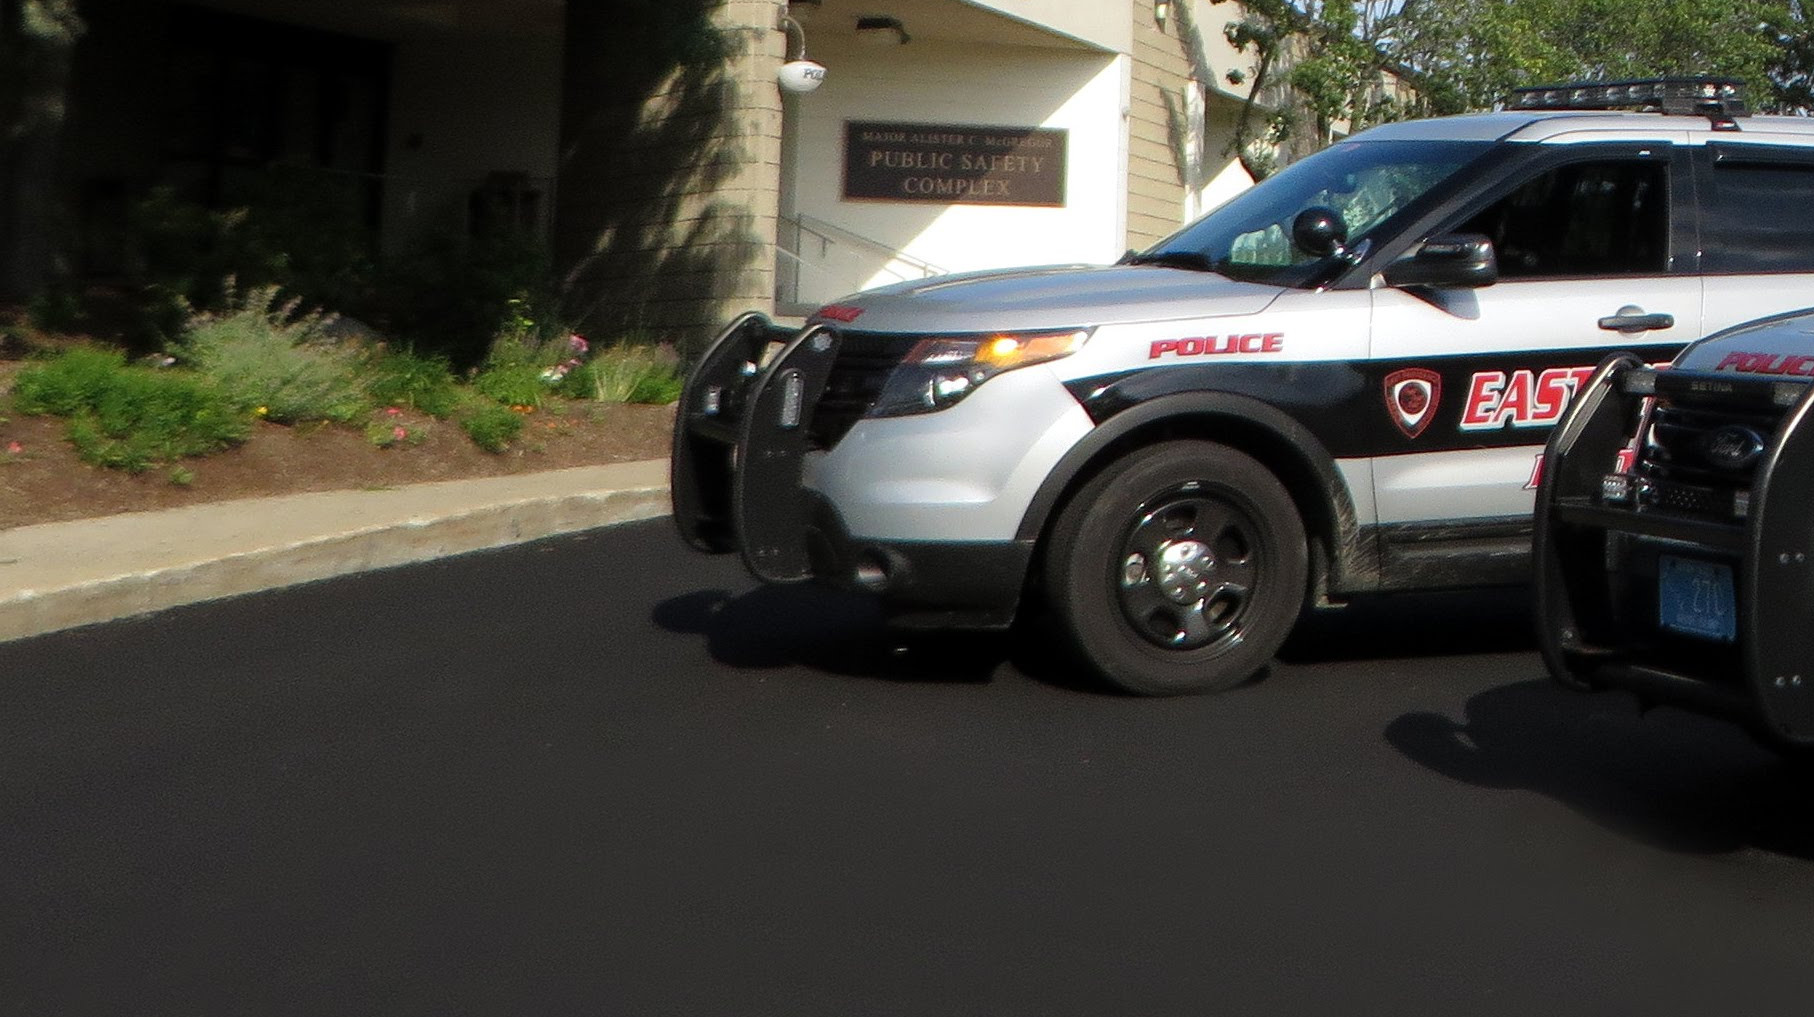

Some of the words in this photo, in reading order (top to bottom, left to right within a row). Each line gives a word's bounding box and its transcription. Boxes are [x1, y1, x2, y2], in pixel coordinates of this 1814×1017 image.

[870, 150, 953, 169] PUBLIC
[961, 153, 1045, 173] SAFETY
[904, 176, 1012, 195] COMPLEX
[1148, 332, 1284, 360] POLICE
